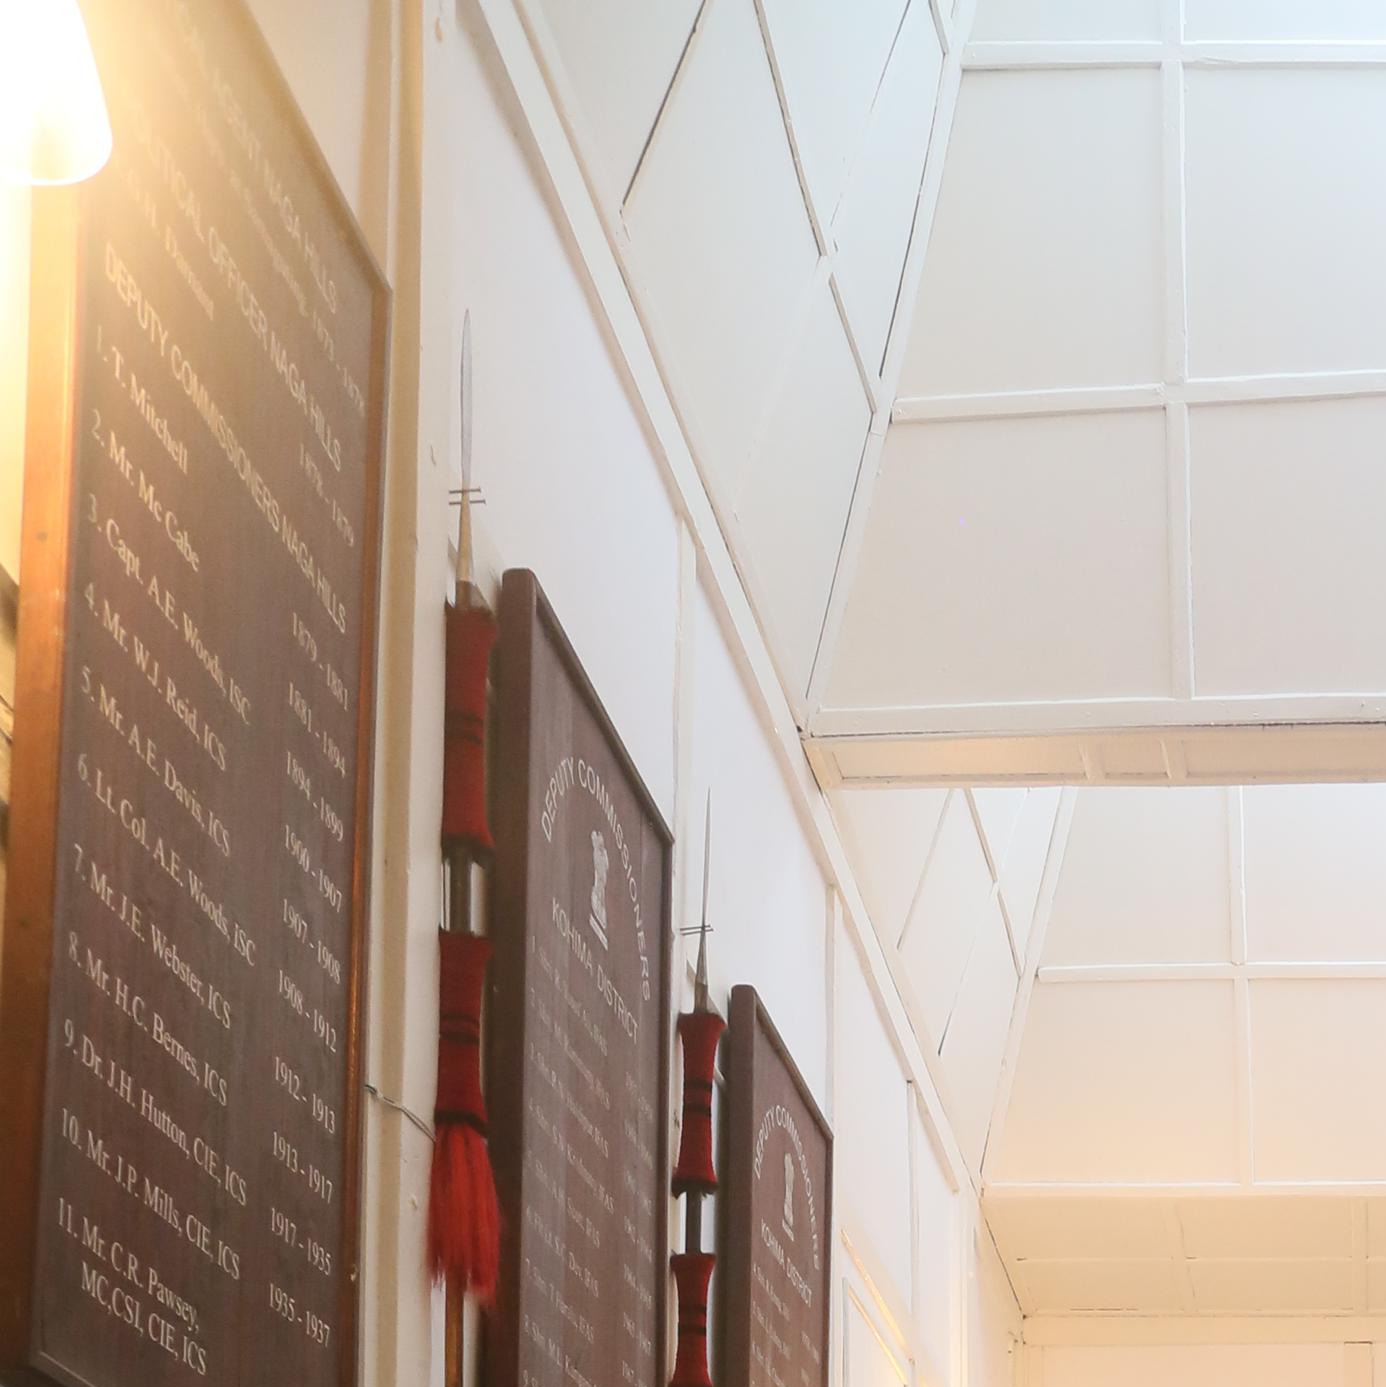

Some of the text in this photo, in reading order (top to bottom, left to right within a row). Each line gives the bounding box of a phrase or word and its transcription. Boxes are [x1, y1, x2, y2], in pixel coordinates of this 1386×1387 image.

[128, 78, 205, 239] OLITICAL
[208, 216, 268, 345] OFFICER
[270, 325, 307, 413] NAGA
[309, 394, 341, 471] HILLS
[263, 155, 301, 252] NAGA
[304, 231, 336, 315] HILLS
[105, 236, 167, 361] DEPUTY
[170, 338, 280, 529] COMMISSIONERS
[282, 511, 315, 588] NAGA
[316, 567, 346, 635] HILLS
[130, 369, 187, 475] Mitchell
[291, 608, 316, 666] 1879
[326, 661, 348, 712] 1881
[331, 495, 354, 552] 1879
[105, 513, 142, 589] Capt.
[148, 568, 178, 631] A.E.
[182, 612, 226, 696] Woods,
[229, 677, 250, 726] ISC
[286, 750, 310, 801] 1894
[319, 796, 343, 846] 1899
[108, 427, 134, 487] Mr.
[165, 505, 199, 575] Cabe
[288, 679, 312, 733] 1881
[322, 728, 345, 781] 1894
[99, 682, 125, 737] Mr.
[128, 716, 160, 775] A.E.
[163, 756, 204, 827] Davis,
[207, 810, 229, 857] ICS
[282, 895, 307, 946] 1907
[316, 936, 340, 985] 1908
[103, 596, 128, 651] Mr.
[133, 634, 162, 693] W.J.
[165, 673, 200, 741] Reid,
[203, 721, 226, 772] ICS
[283, 821, 309, 874] 1900
[318, 867, 341, 915] 1907
[90, 860, 114, 909] Mr.
[119, 890, 145, 941] J.E.
[150, 922, 204, 1003] Webster,
[207, 982, 230, 1028] ICS
[274, 1054, 299, 1100] 1912
[311, 1090, 335, 1135] 1913
[156, 834, 184, 887] A.E.
[187, 868, 231, 942] Woods,
[234, 922, 256, 968] ISC
[278, 965, 302, 1016] 1908
[312, 1006, 336, 1053] 1912
[540, 756, 575, 842] DEPUTY
[577, 759, 650, 1002] COMMISSIONERS
[552, 897, 593, 978] KOHIMA
[597, 976, 638, 1047] DISTRICT
[82, 1033, 103, 1078] Dr.
[107, 1057, 135, 1107] J.H.
[140, 1087, 190, 1157] Hutton,
[193, 1135, 221, 1187] CIE,
[224, 1163, 247, 1206] ICS
[270, 1204, 296, 1249] 1917
[306, 1234, 331, 1277] 1935
[86, 946, 110, 995] Mr.
[114, 975, 147, 1031] H.C.
[203, 1061, 227, 1108] ICS
[272, 1127, 297, 1174] 1913
[308, 1160, 333, 1205] 1917
[754, 1104, 776, 1181] DEPUTY
[57, 1195, 199, 1336] 11. Mr. C.R. Pawsey,
[60, 1106, 330, 1350] 10. Mr. J.P. Mills, CIE, ICS 1935 1937
[760, 1218, 785, 1274] KOHIMA
[786, 1263, 812, 1309] DISTRICT
[182, 1333, 206, 1375] ICS
